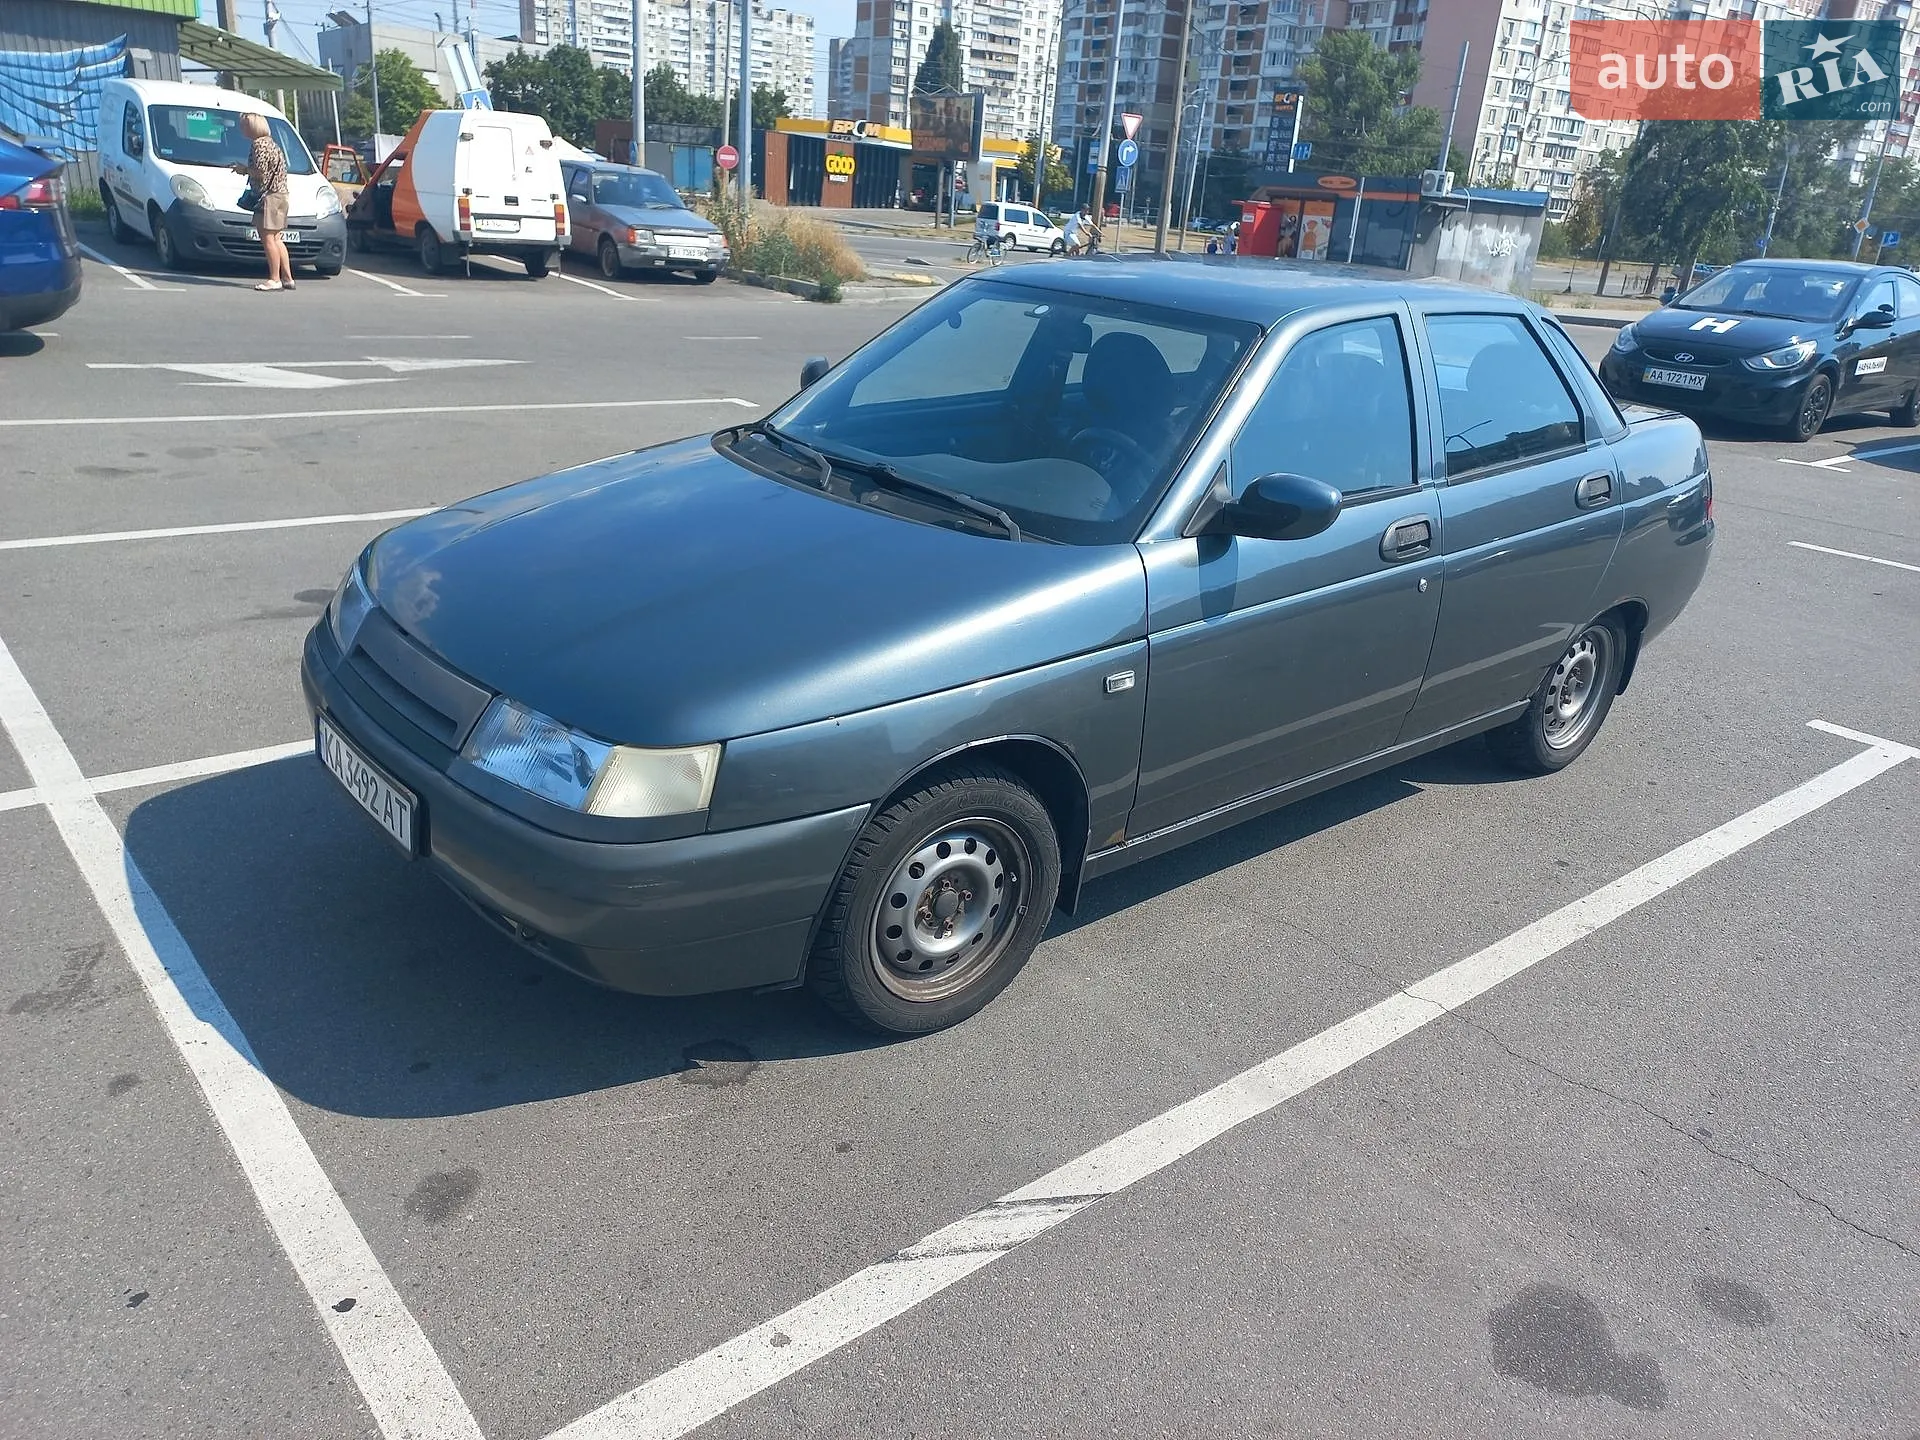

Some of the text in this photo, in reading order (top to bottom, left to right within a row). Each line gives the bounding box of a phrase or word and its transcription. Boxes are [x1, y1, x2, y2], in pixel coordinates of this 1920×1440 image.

[825, 154, 856, 175] GOOD
[1650, 368, 1705, 388] AA 1721 MX
[325, 727, 407, 839] KA 3492 AT
